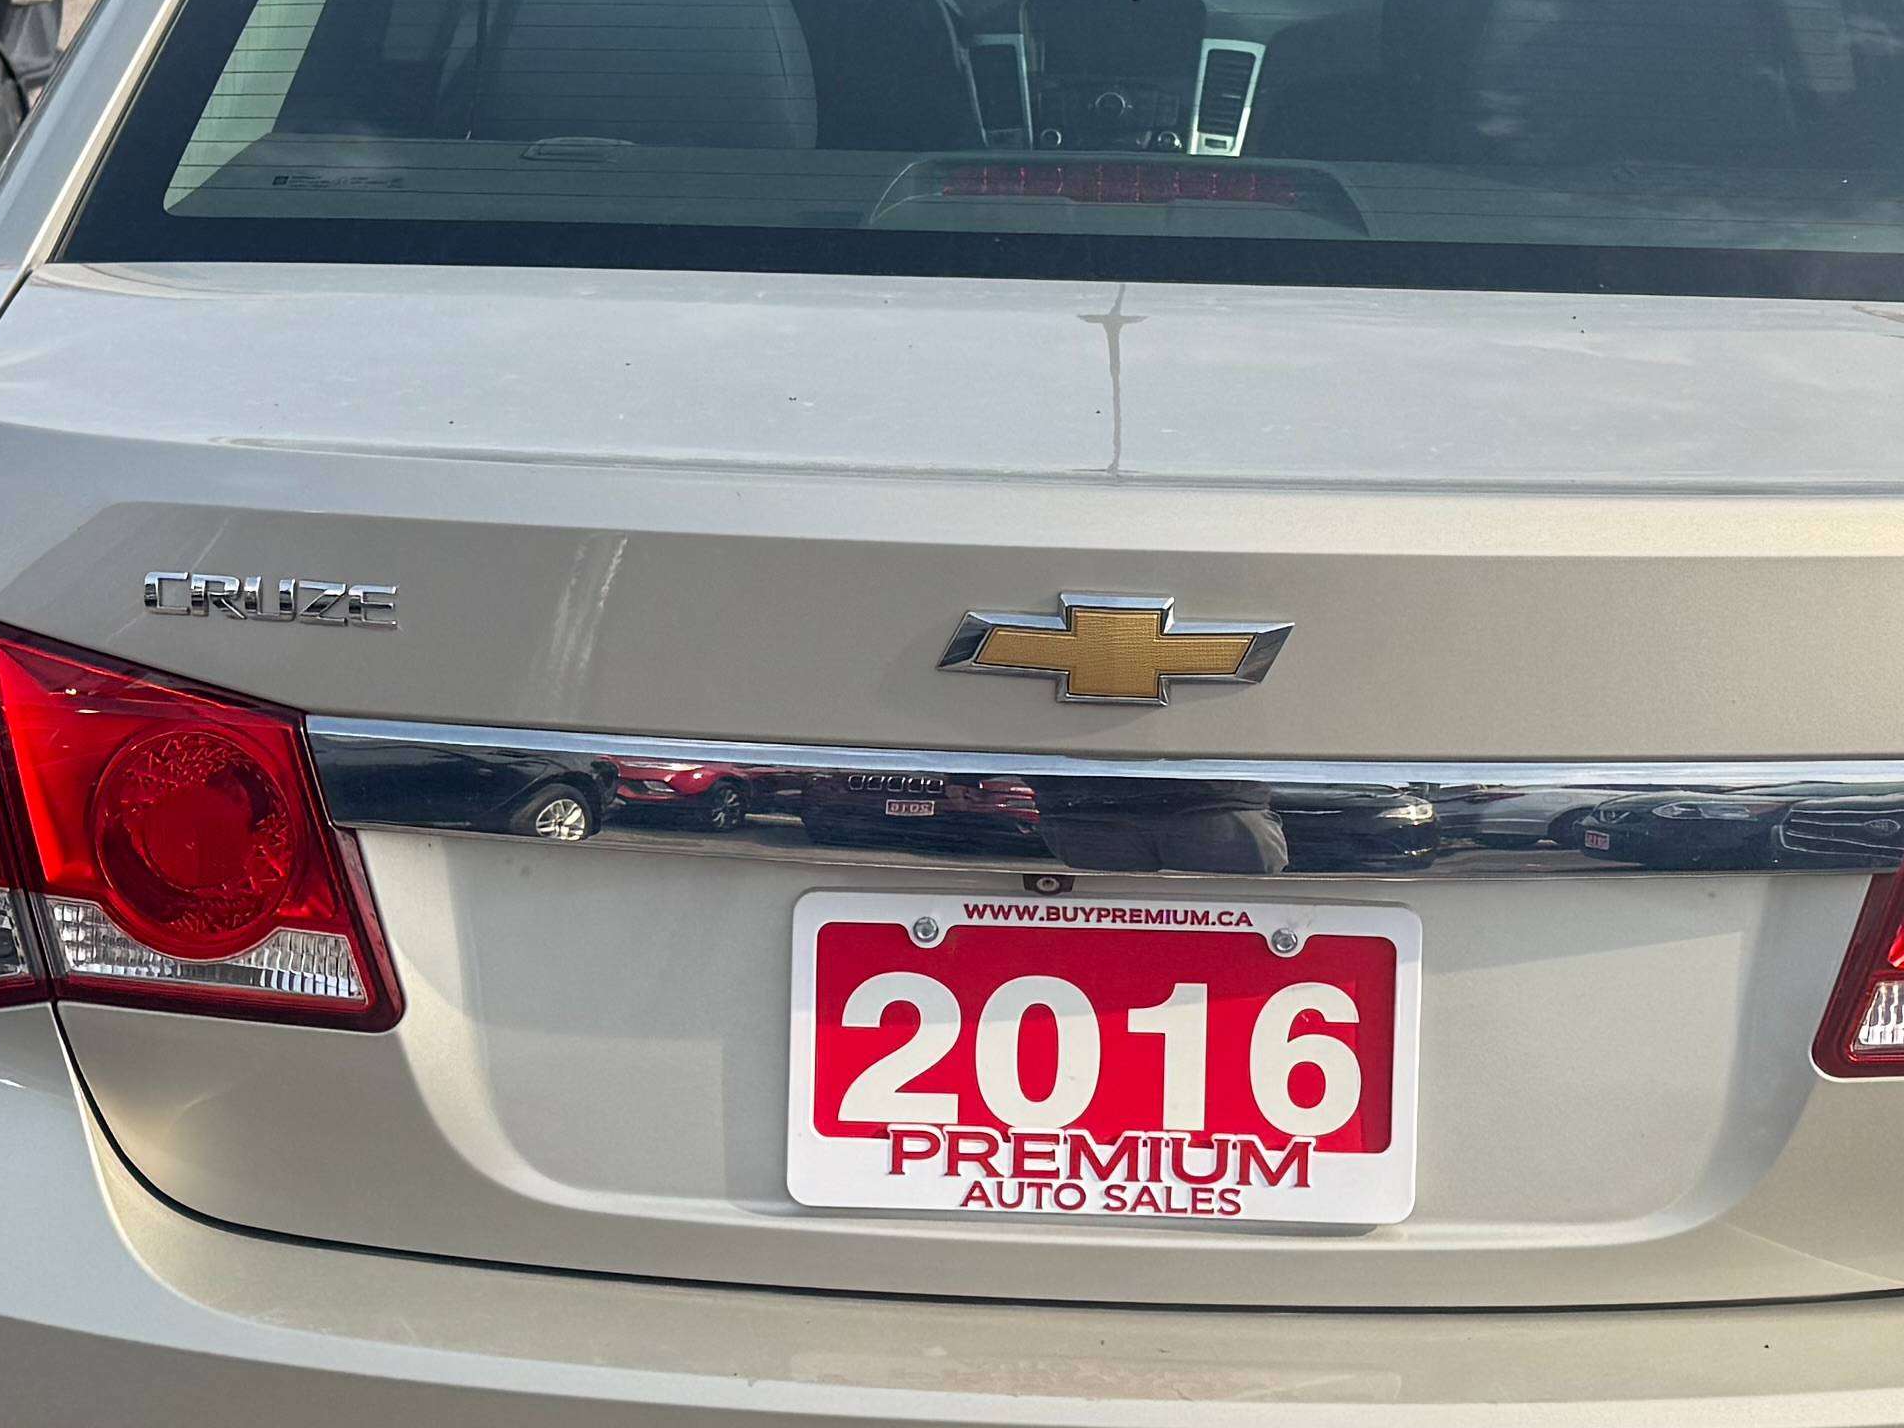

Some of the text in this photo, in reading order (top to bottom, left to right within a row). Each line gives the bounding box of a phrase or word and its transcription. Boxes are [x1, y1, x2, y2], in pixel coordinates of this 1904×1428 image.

[144, 572, 398, 628] CRUZE
[963, 903, 1254, 927] WWW.BUYPREMIUM.CA
[837, 972, 1362, 1136] 2016
[887, 1127, 1315, 1189] PREMIUM
[960, 1180, 1243, 1215] AUTO SALES
